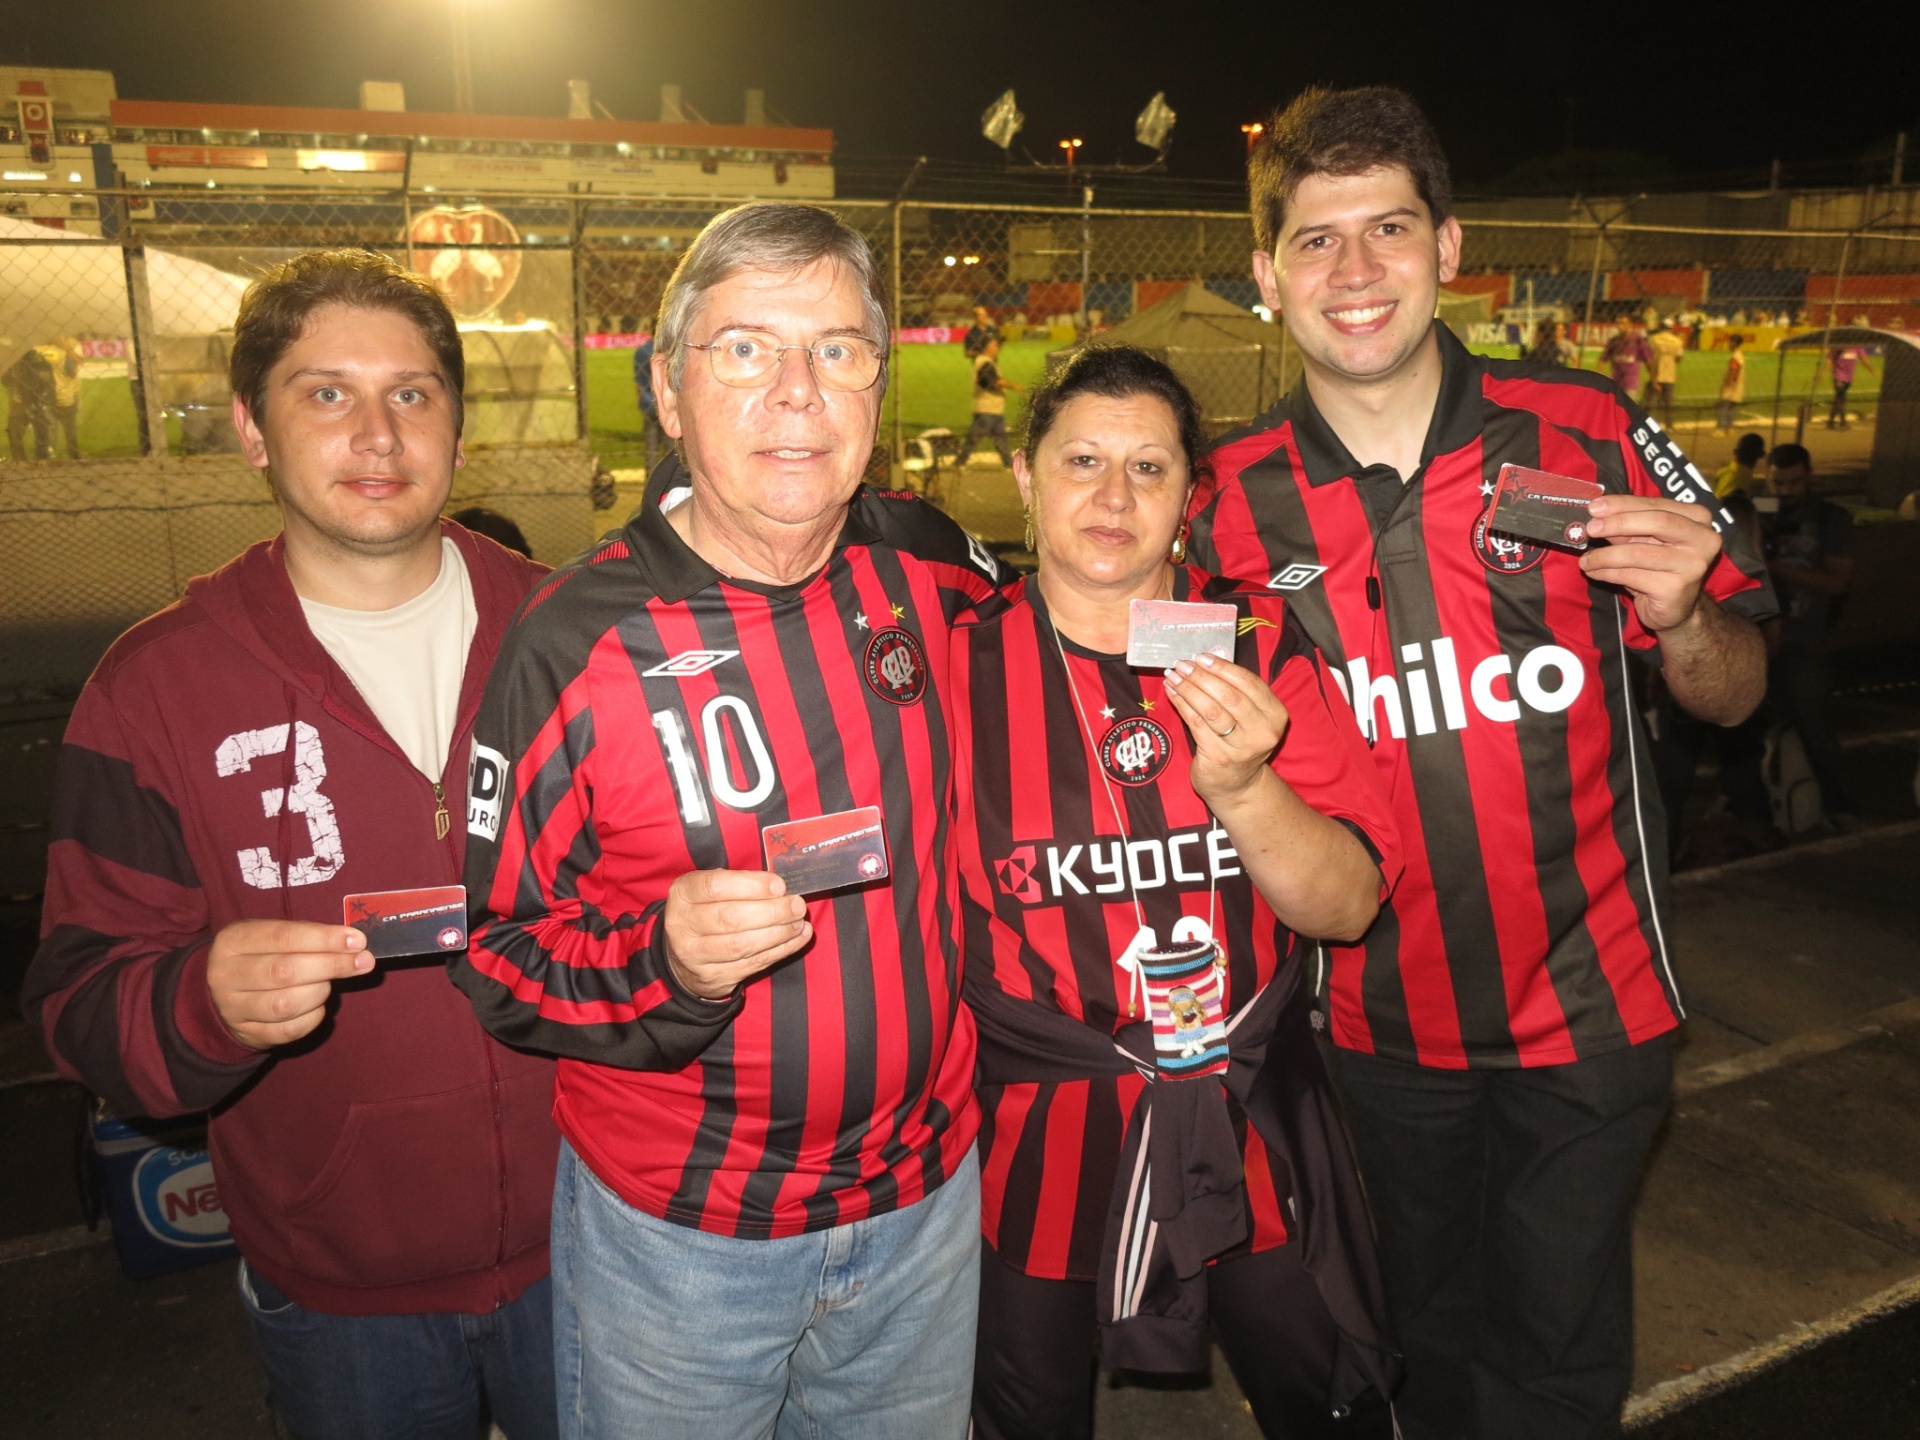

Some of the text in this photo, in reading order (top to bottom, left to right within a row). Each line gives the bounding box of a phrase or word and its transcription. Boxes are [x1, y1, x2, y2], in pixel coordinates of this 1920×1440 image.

[1467, 322, 1507, 344] VISA
[1633, 427, 1722, 533] SEGUR
[1329, 637, 1585, 742] hilco
[214, 719, 346, 890] 3
[652, 694, 776, 827] 10
[1046, 828, 1246, 897] KYOCE
